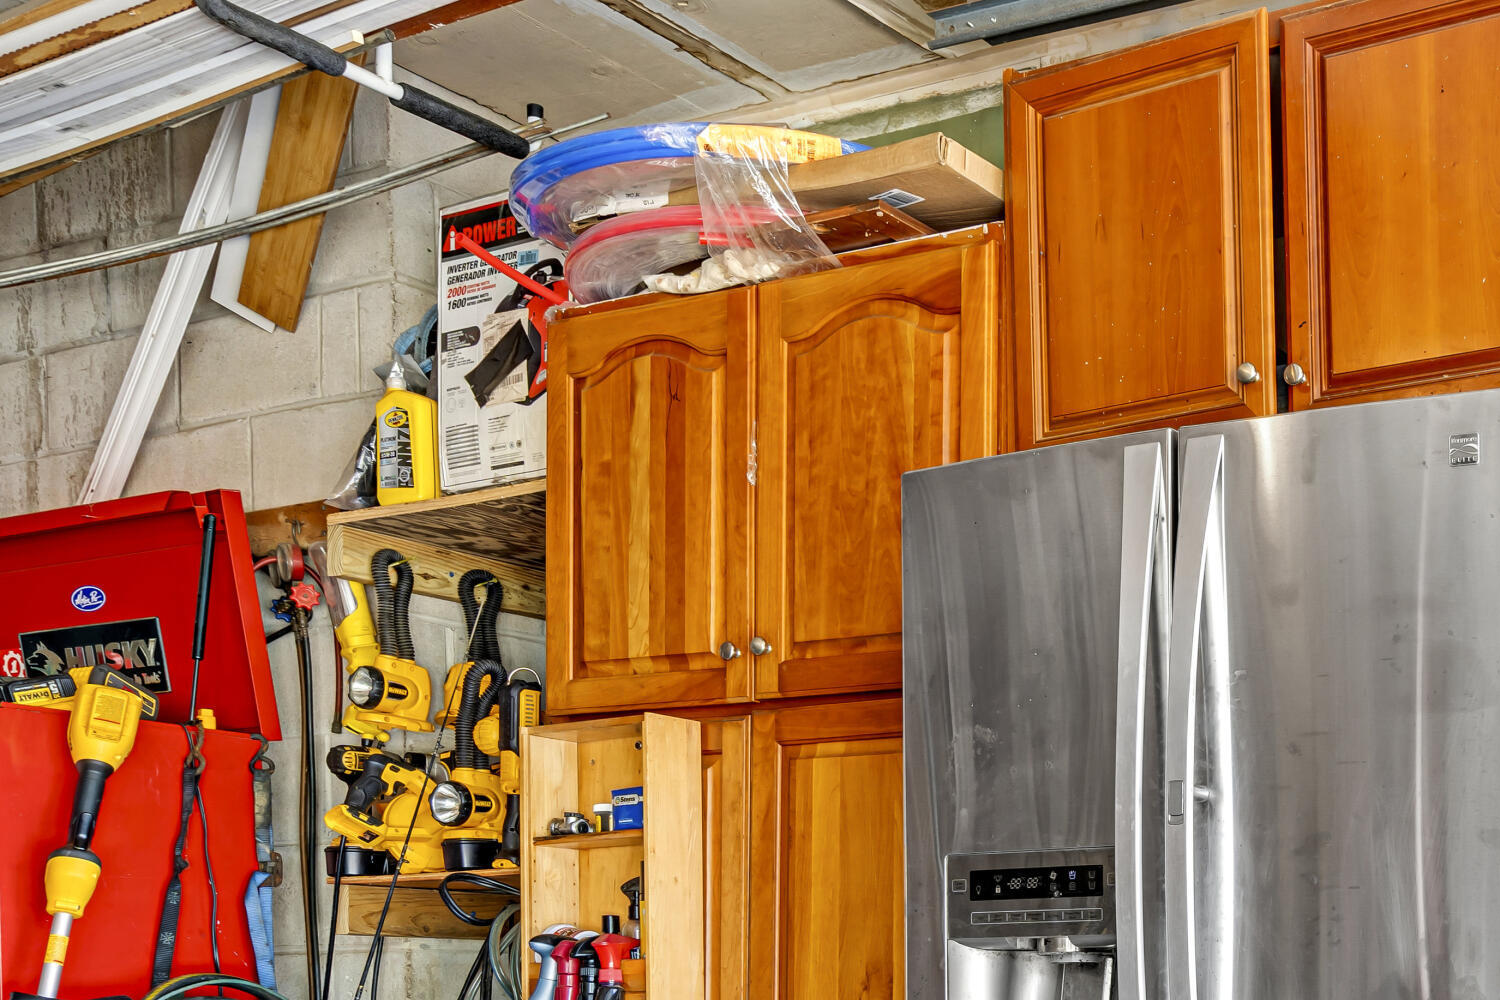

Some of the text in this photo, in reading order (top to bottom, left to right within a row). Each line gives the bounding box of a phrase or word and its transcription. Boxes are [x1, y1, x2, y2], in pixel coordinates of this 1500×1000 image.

[446, 259, 479, 275] INVERTER
[447, 269, 486, 285] GENERADOR
[446, 285, 467, 299] 2000
[447, 297, 467, 311] 1600
